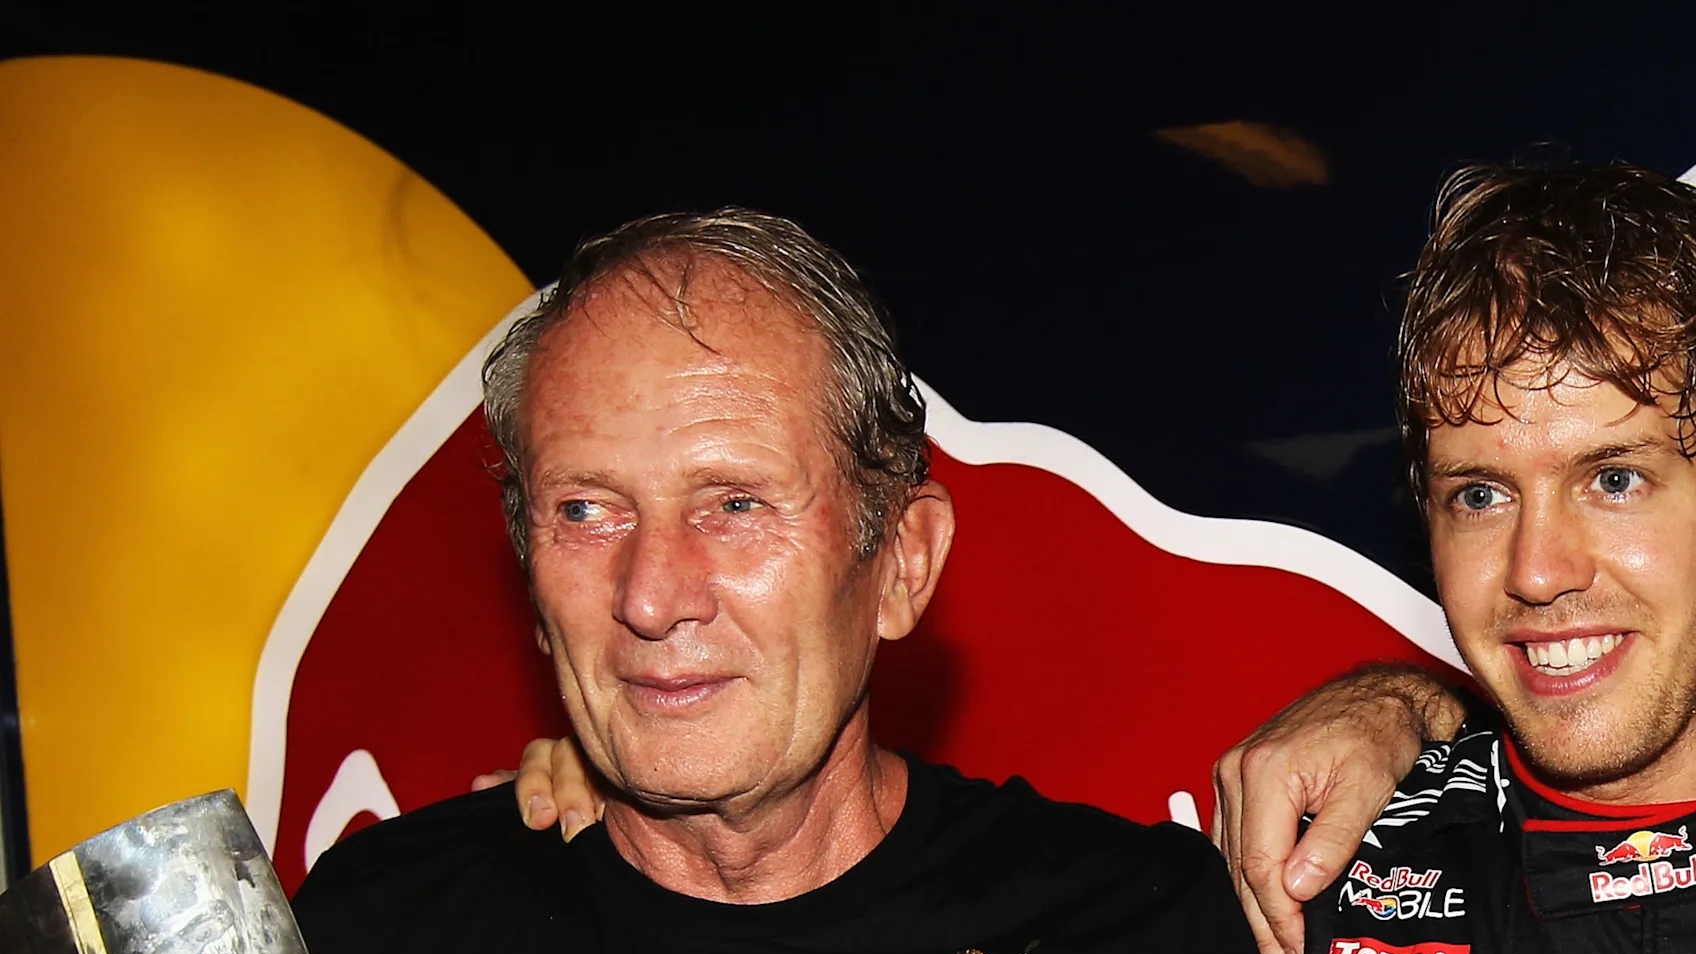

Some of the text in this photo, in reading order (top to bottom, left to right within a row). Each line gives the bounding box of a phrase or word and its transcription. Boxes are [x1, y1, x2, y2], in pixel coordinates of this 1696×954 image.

[1348, 860, 1443, 892] Red Bull
[1589, 863, 1653, 904] Red
[1338, 880, 1465, 921] MOBILE
